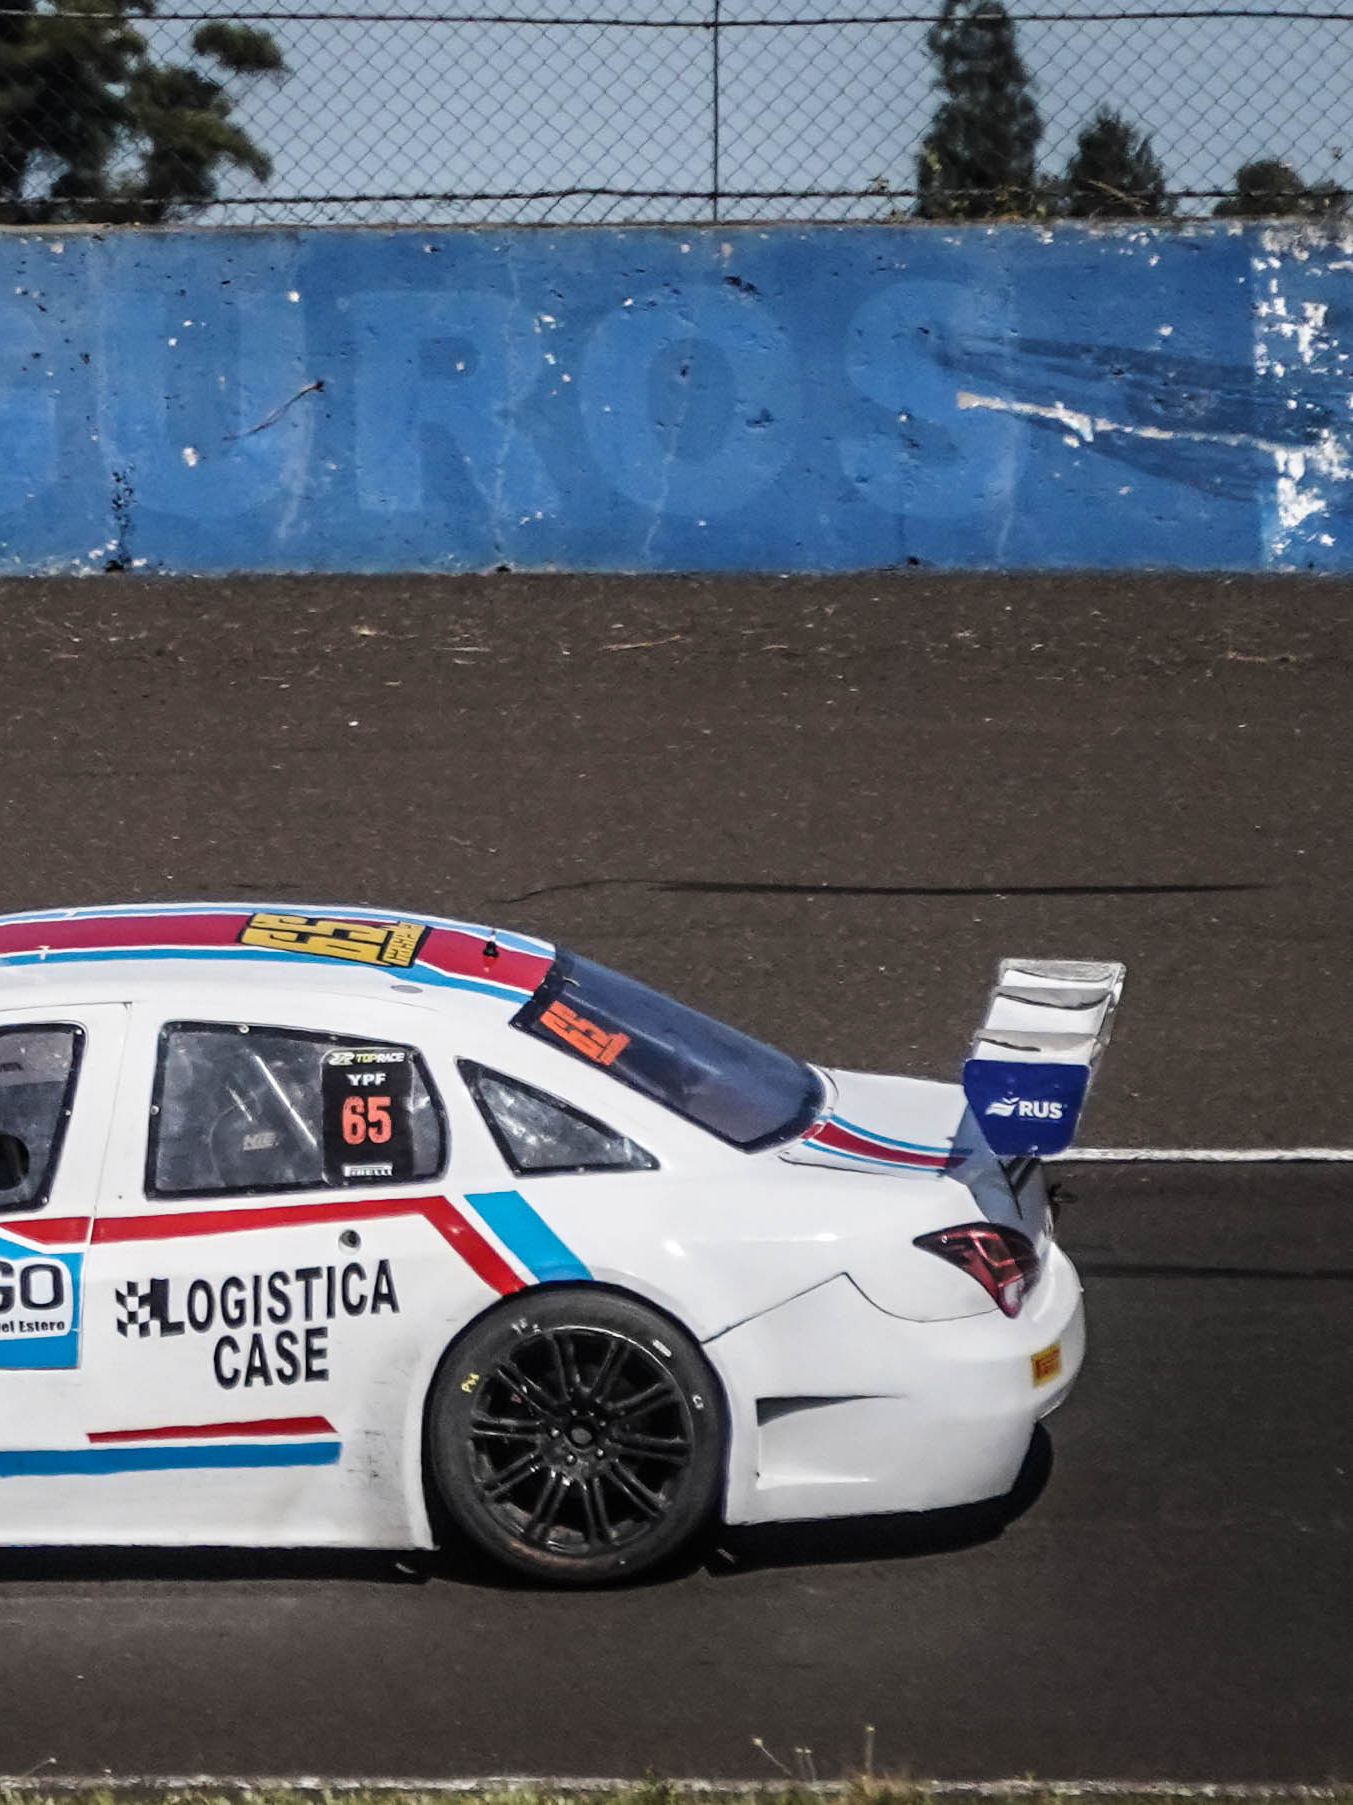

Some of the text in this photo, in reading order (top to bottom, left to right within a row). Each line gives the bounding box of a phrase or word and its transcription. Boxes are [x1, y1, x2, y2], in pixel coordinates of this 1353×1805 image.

[346, 1073, 386, 1086] YPF
[342, 1095, 392, 1145] 65
[1018, 1100, 1063, 1119] RUS
[149, 1258, 400, 1337] LOGISTICA
[19, 1320, 65, 1332] Estero
[213, 1326, 330, 1390] CASE
